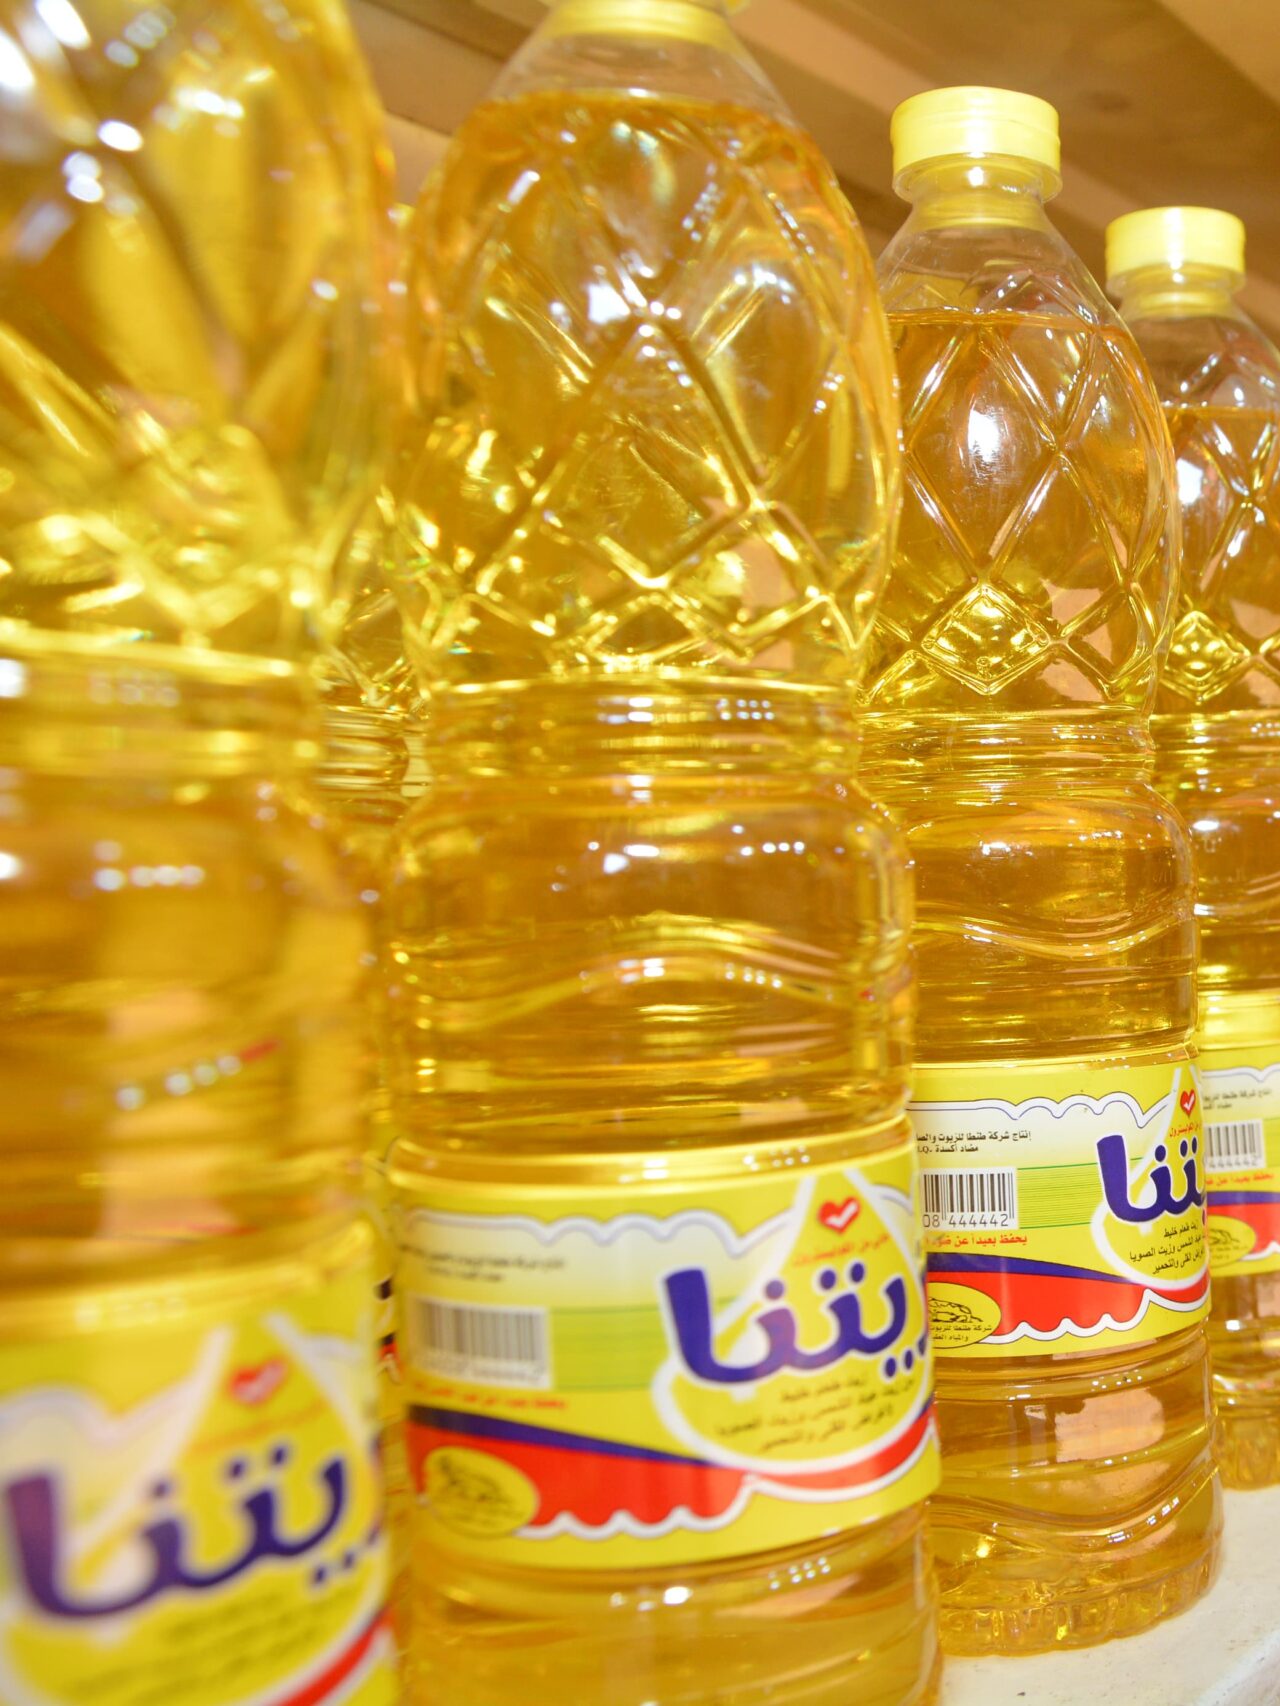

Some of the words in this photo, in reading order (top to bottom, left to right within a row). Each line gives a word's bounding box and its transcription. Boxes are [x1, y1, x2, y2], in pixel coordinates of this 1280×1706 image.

[916, 1133, 936, 1144] والصا
[939, 1133, 964, 1144] للزيوت
[967, 1131, 986, 1141] طنطا
[989, 1130, 1009, 1142] شركة
[949, 1213, 1009, 1229] 444442
[954, 1235, 969, 1247] عن
[1000, 1233, 1028, 1246] يحفظ
[1130, 1247, 1155, 1262] الصويا
